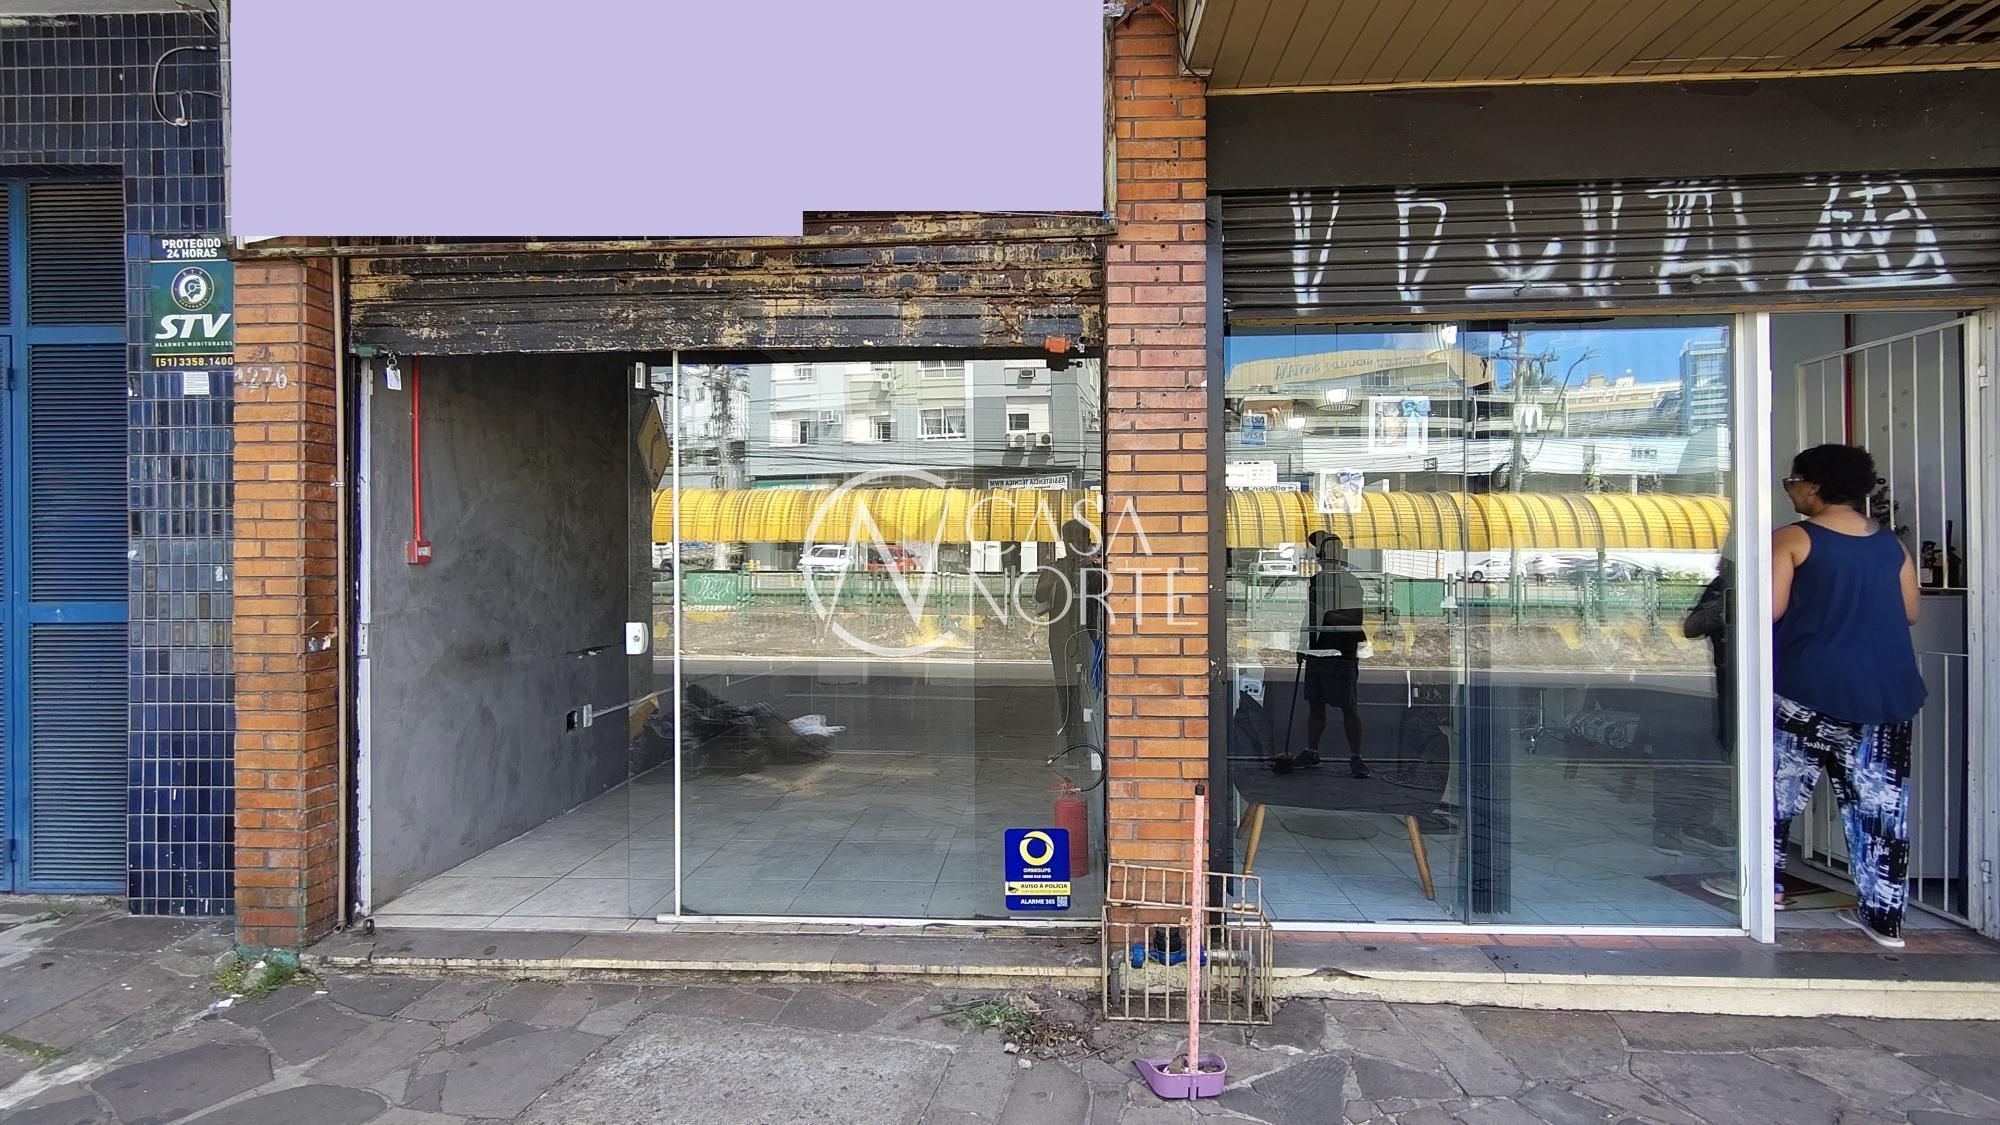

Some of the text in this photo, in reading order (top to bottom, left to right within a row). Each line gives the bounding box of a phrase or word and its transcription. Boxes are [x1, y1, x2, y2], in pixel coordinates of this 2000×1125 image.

[162, 238, 221, 249] PROTEGIDO
[166, 248, 218, 258] 24 HORAS
[155, 313, 232, 339] STV
[156, 357, 234, 367] (51) 3358.1400
[234, 366, 288, 389] 1276
